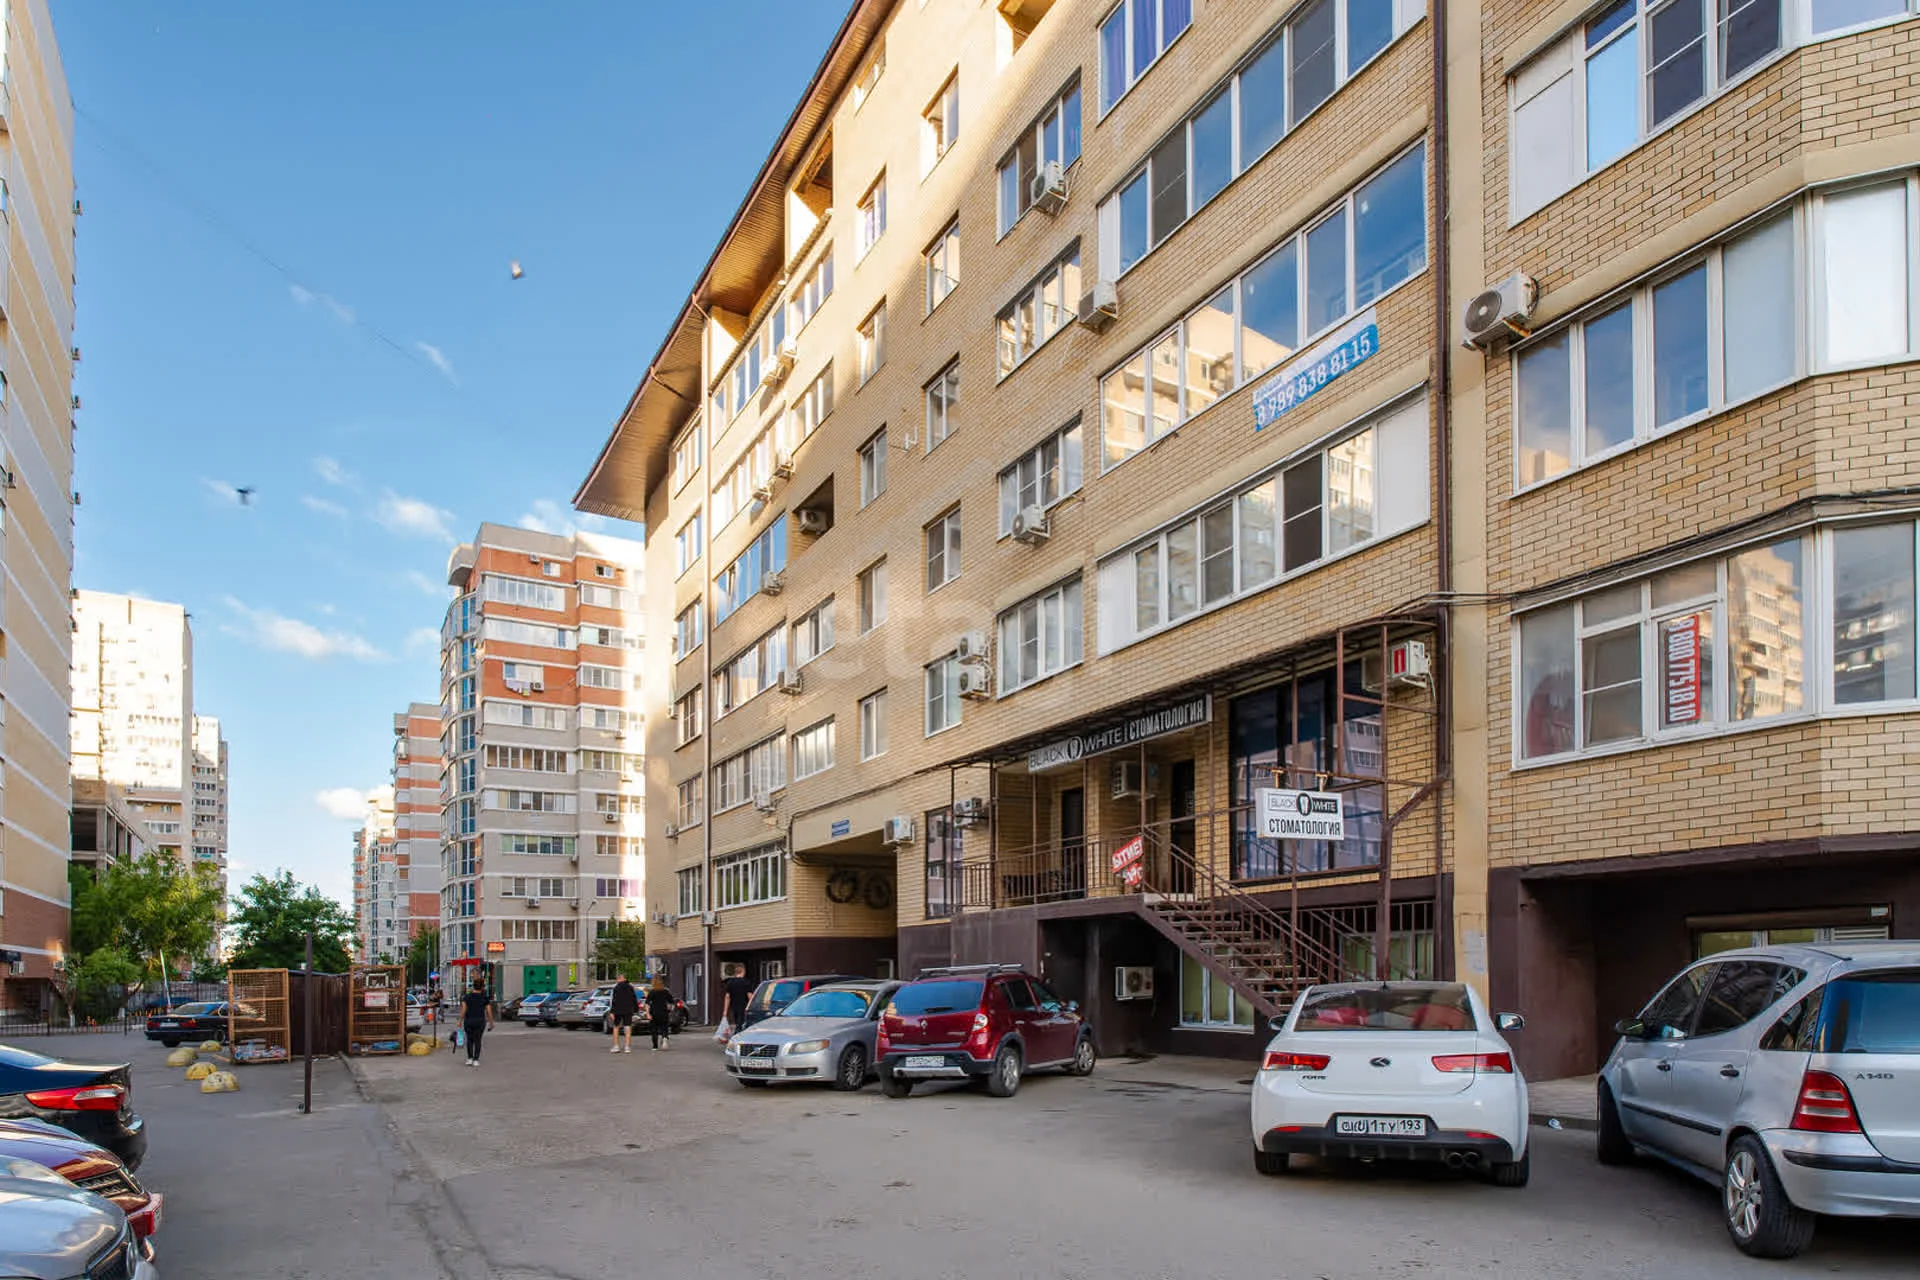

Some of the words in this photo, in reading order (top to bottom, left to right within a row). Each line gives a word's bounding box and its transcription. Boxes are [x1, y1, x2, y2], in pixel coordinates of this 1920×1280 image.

[1298, 363, 1327, 398] 838
[1330, 351, 1350, 376] 81
[1351, 331, 1371, 363] 15
[1029, 747, 1065, 768] BLACK
[1083, 727, 1121, 752] WHITE
[1129, 699, 1204, 741] СТОМАТОЛОГИЯ
[1271, 797, 1296, 809] BLACK
[1312, 800, 1337, 812] WHITE
[1268, 818, 1341, 836] СТОМАТОЛОГИЯ
